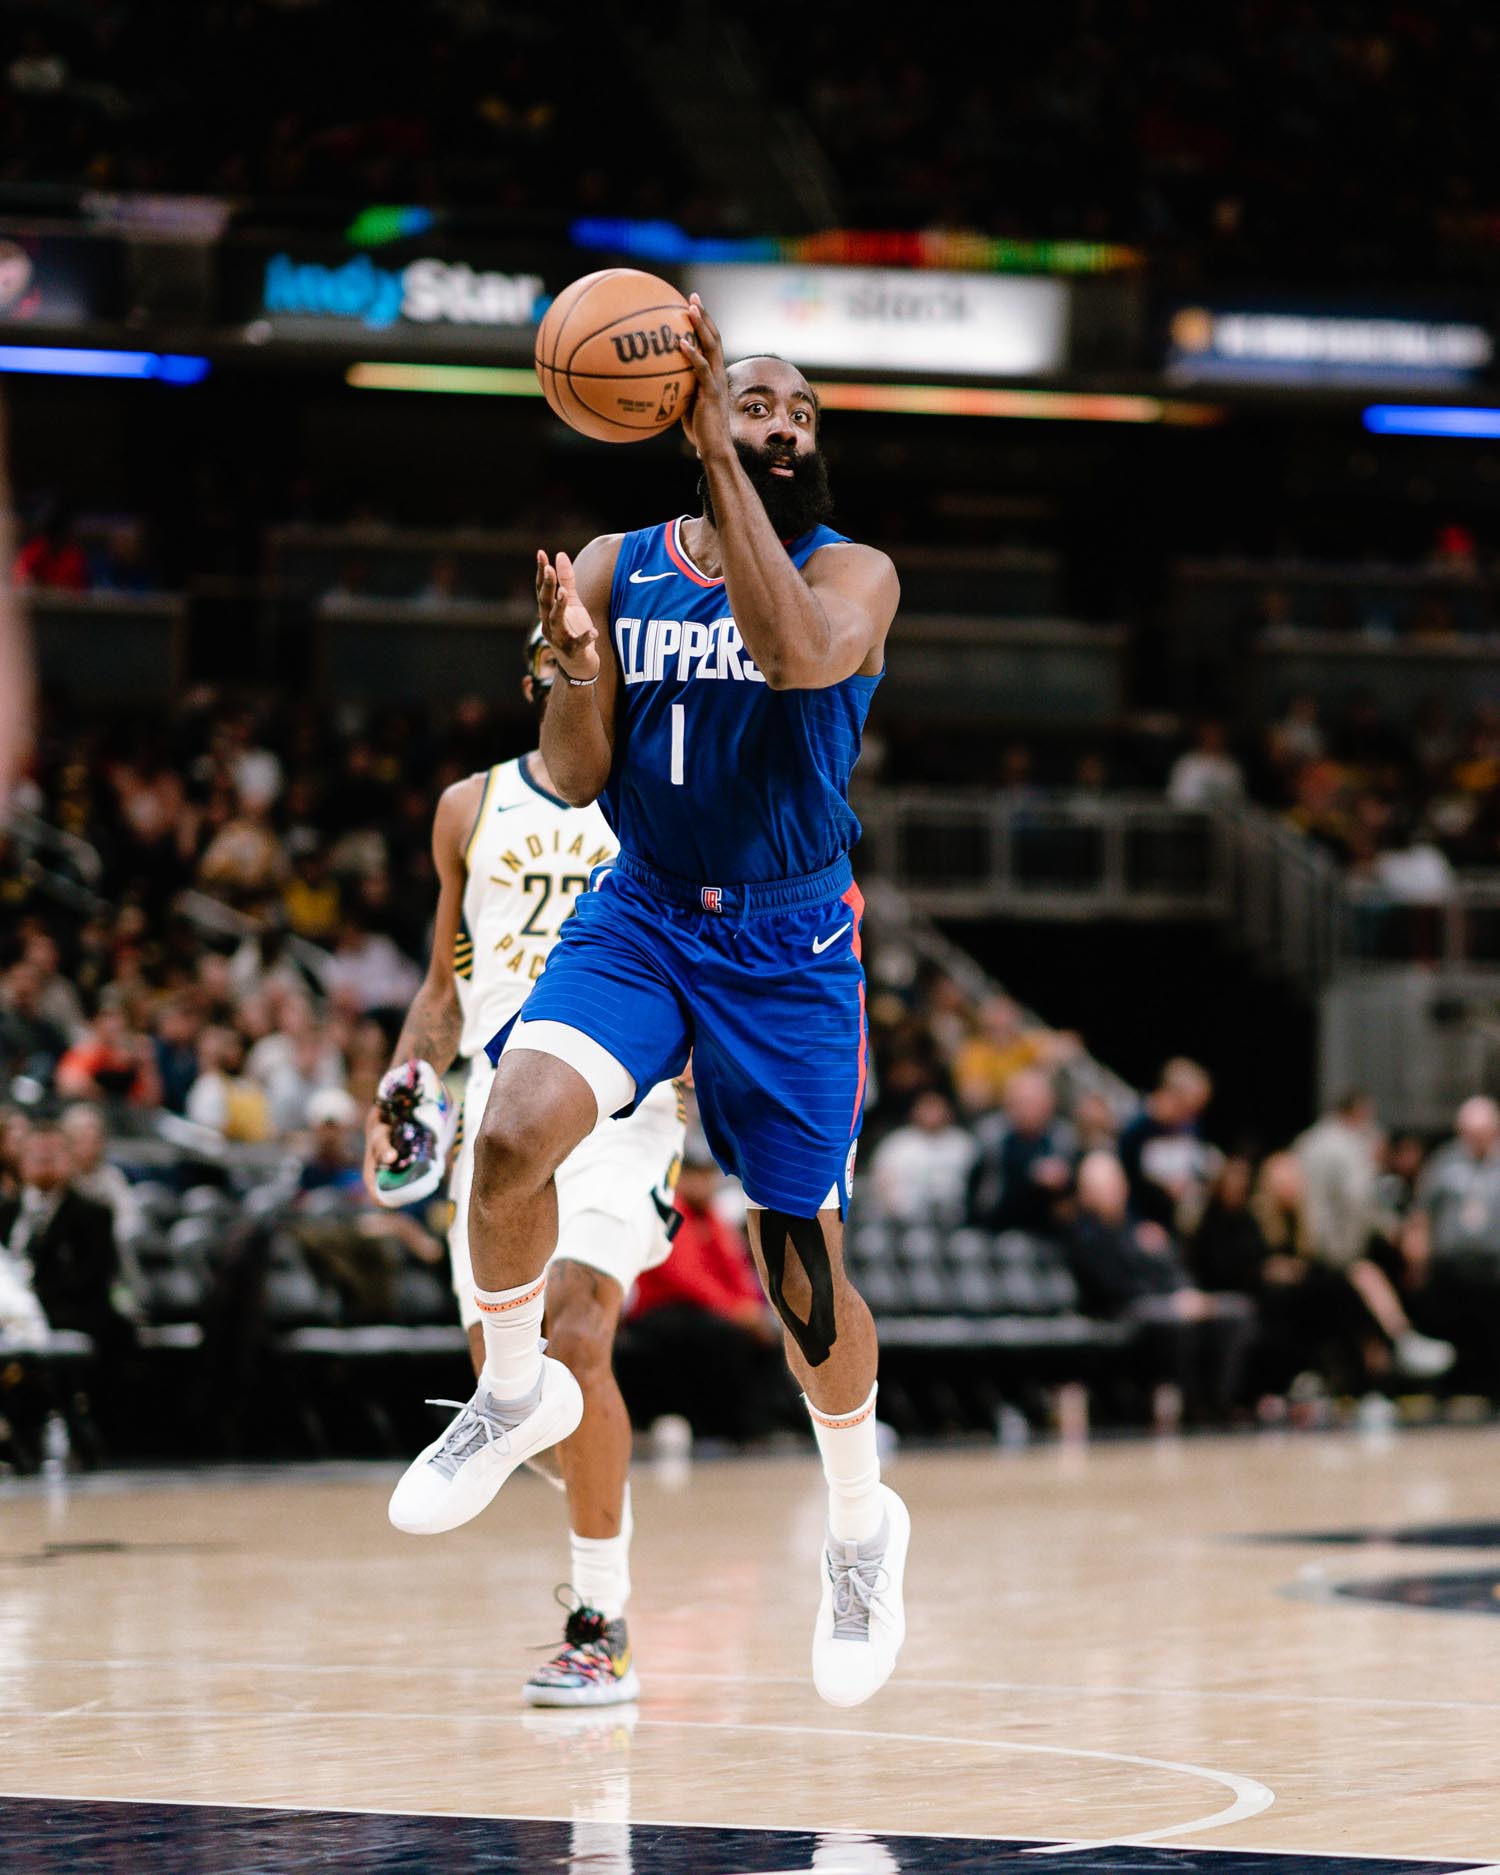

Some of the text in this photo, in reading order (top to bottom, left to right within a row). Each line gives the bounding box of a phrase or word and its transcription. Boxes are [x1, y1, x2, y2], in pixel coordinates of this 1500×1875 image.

[671, 704, 685, 785] 1
[489, 829, 612, 888] INDIAN
[494, 933, 546, 980] PAC
